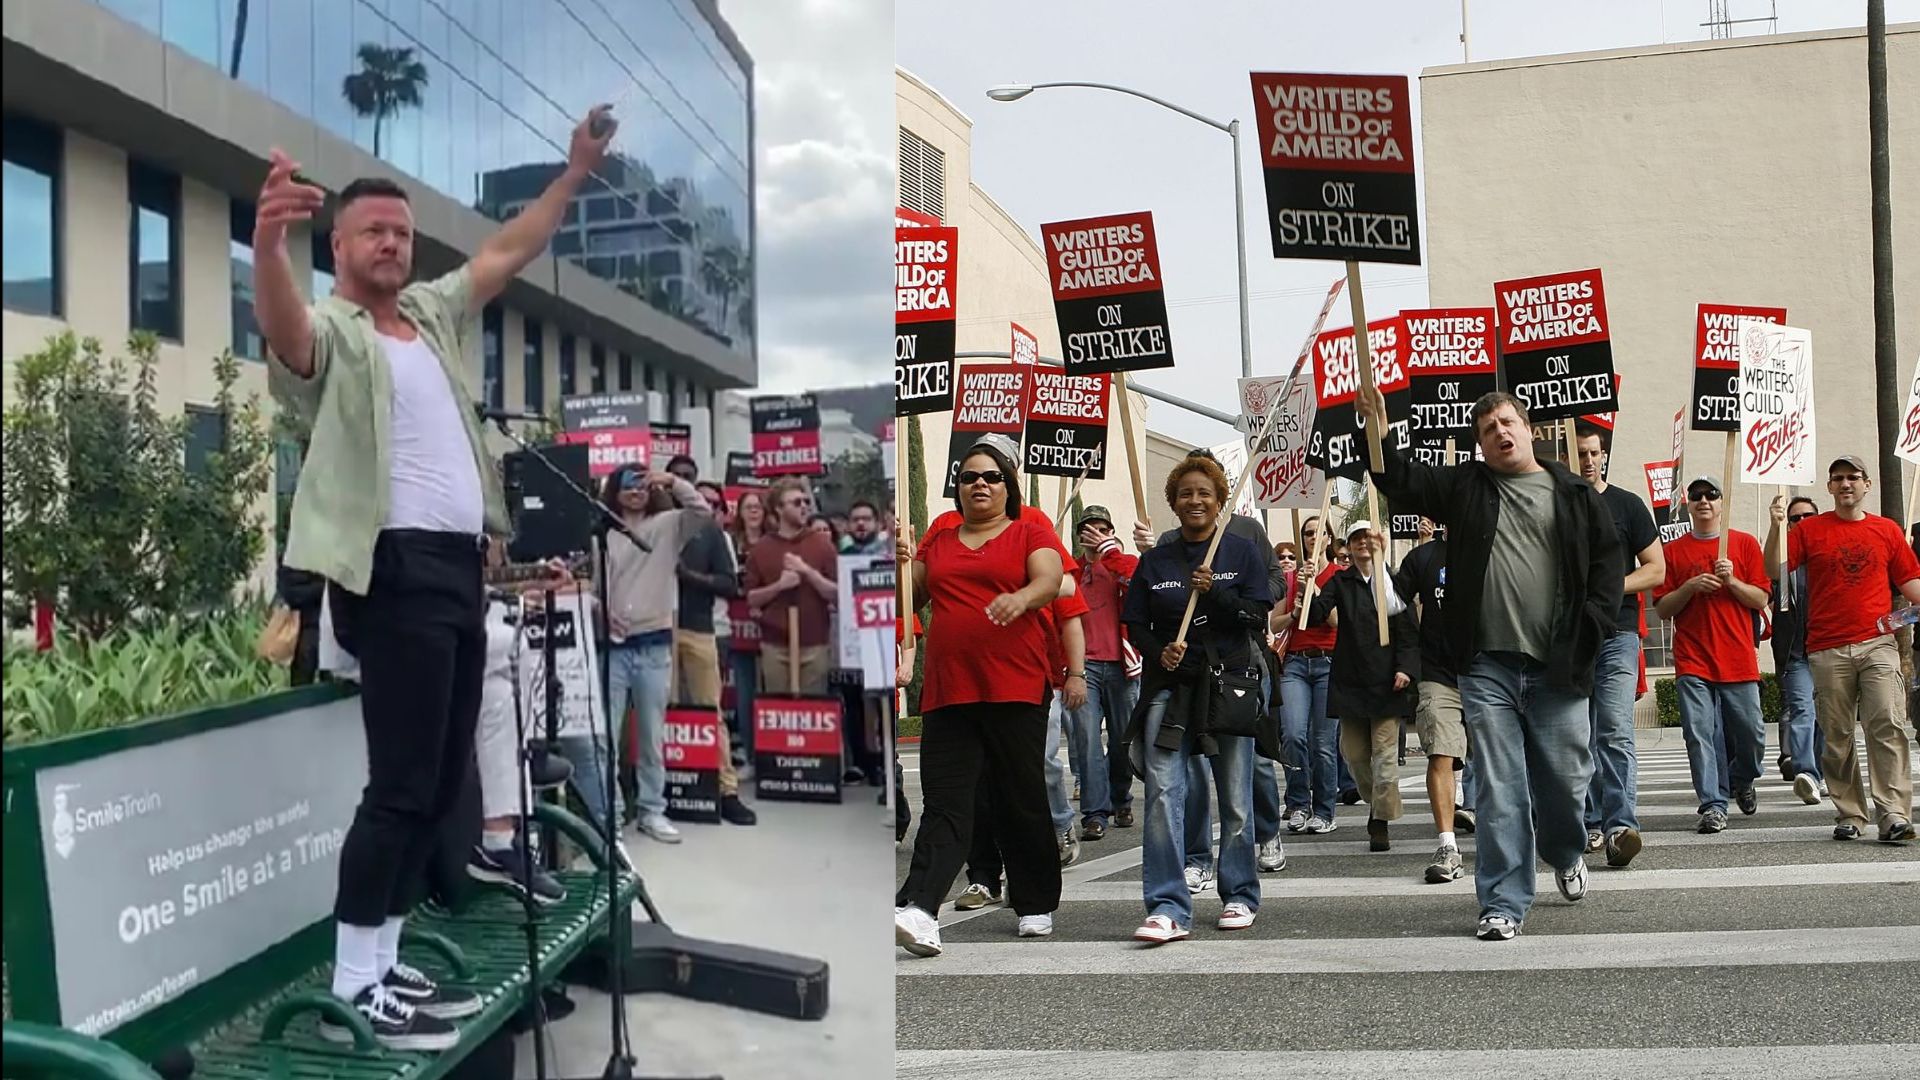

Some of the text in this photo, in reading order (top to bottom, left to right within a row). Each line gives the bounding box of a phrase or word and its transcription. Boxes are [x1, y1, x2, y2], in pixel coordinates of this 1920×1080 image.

[1263, 85, 1394, 113] WRITERS
[1273, 109, 1392, 137] GUILD OF
[1270, 133, 1404, 161] AMERICA
[1322, 181, 1355, 208] ON
[1050, 223, 1145, 251] WRITERS
[1278, 208, 1411, 250] STRIKE
[895, 240, 948, 263] ITERS
[1059, 246, 1145, 271] GUILD OF
[895, 265, 946, 288] ILD OF
[1058, 263, 1155, 291] AMERICA
[895, 287, 951, 311] ERICA
[1502, 280, 1593, 308] WRITERS
[1097, 304, 1122, 327] ON
[1510, 302, 1593, 325] GUILD OF
[1406, 316, 1486, 335] WRITERS
[1508, 316, 1603, 344] AMERICA
[1706, 329, 1739, 345] GUI
[1067, 325, 1166, 364] STRIKE
[1318, 326, 1397, 361] WRIERS
[1411, 334, 1485, 351] GUILD OF
[1324, 349, 1397, 379] GUID OF
[1408, 349, 1490, 367] AMERICA
[1545, 355, 1570, 376] ON
[1771, 358, 1786, 370] THE
[963, 373, 1023, 390] WRITERS
[1034, 372, 1102, 391] WRITERS
[1438, 382, 1460, 400] ON
[1515, 373, 1611, 411] STRIKE
[1728, 376, 1740, 394] O
[1744, 367, 1794, 394] WRITERS
[963, 390, 1019, 407] GUILD OF
[1036, 387, 1100, 405] GUILD OF
[1744, 392, 1784, 415] GUILD
[956, 407, 1021, 424] AMERICA
[1032, 400, 1104, 419] AMERICA
[1411, 402, 1477, 430] STRIK
[1698, 395, 1740, 421] STR
[1246, 415, 1299, 432] WRERS
[1055, 428, 1075, 444] ON
[1249, 435, 1288, 452] ILD
[756, 447, 817, 467] STRIKE!
[1029, 443, 1102, 470] STRIKE
[758, 709, 836, 732] STRIKE!
[75, 791, 161, 832] SmileTrain
[149, 799, 310, 876] Help us change the world
[118, 827, 344, 943] One Smile at a Time
